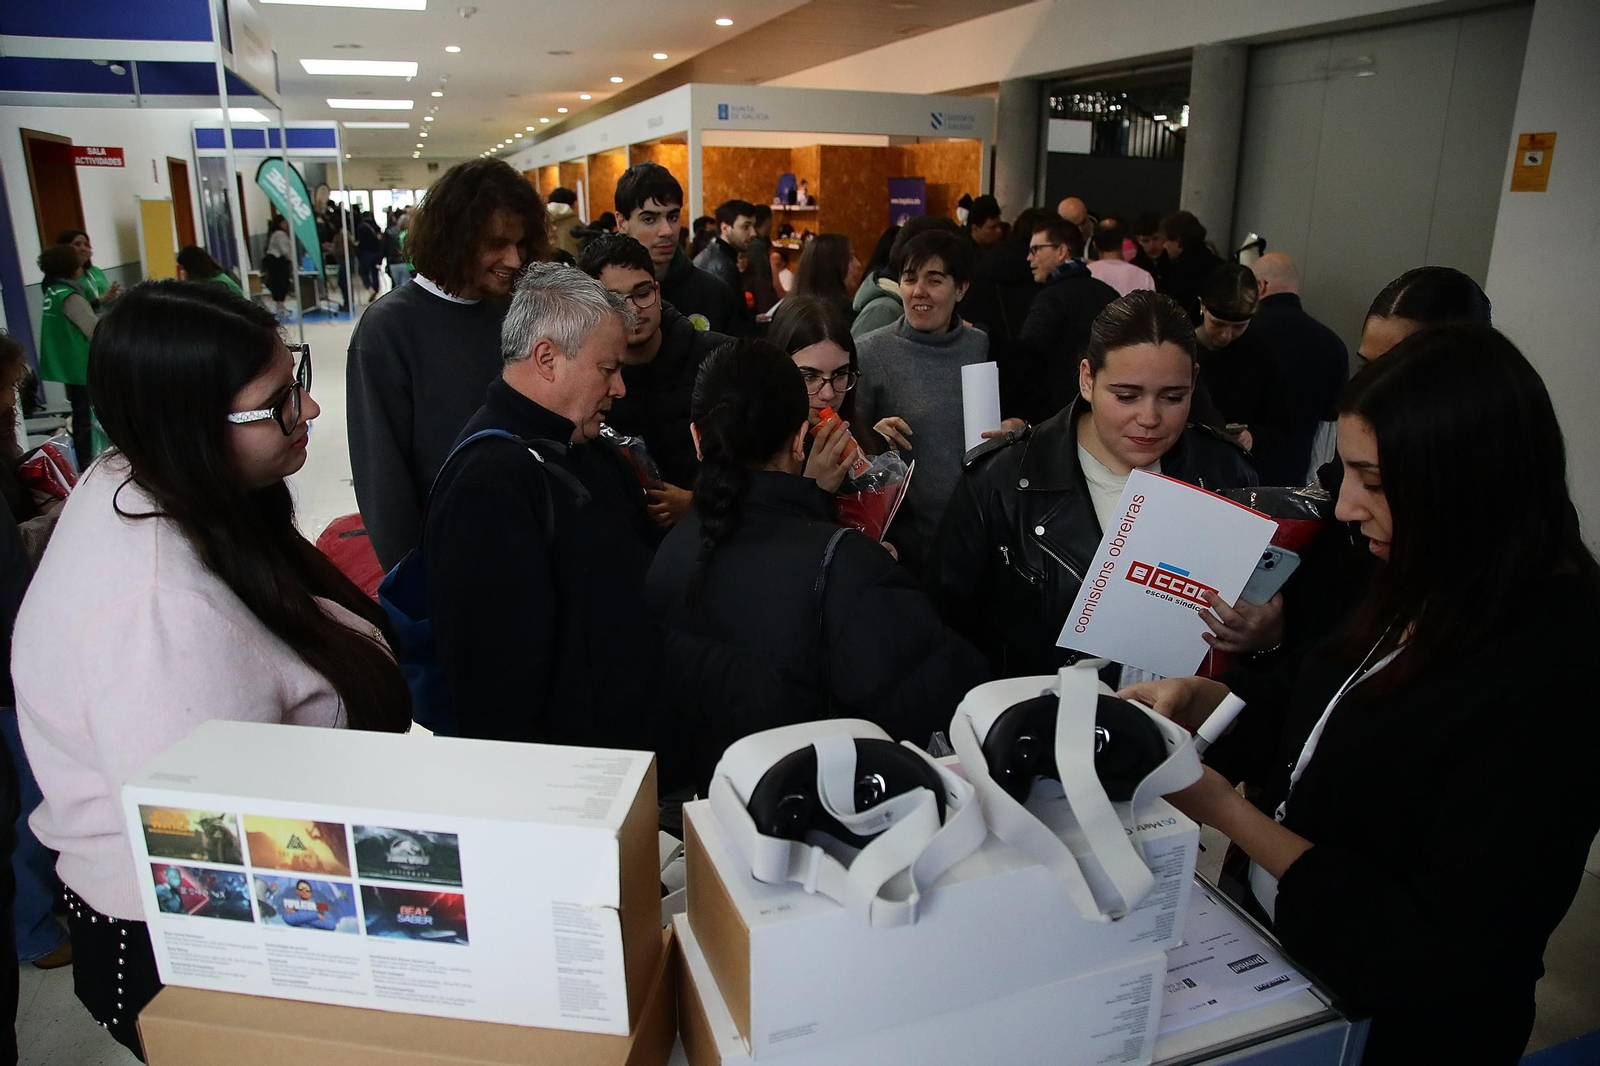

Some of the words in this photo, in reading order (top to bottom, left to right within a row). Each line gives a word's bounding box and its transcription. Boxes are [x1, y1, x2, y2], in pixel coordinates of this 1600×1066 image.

[87, 147, 107, 156] SALA
[74, 156, 122, 166] ACTIVIDADES
[1074, 561, 1115, 633] comisións
[1109, 494, 1145, 557] obreiras
[1145, 589, 1173, 602] escola
[1175, 598, 1201, 612] sindic
[400, 905, 429, 916] BEAT
[397, 913, 434, 926] SABER
[1231, 955, 1265, 973] previsel
